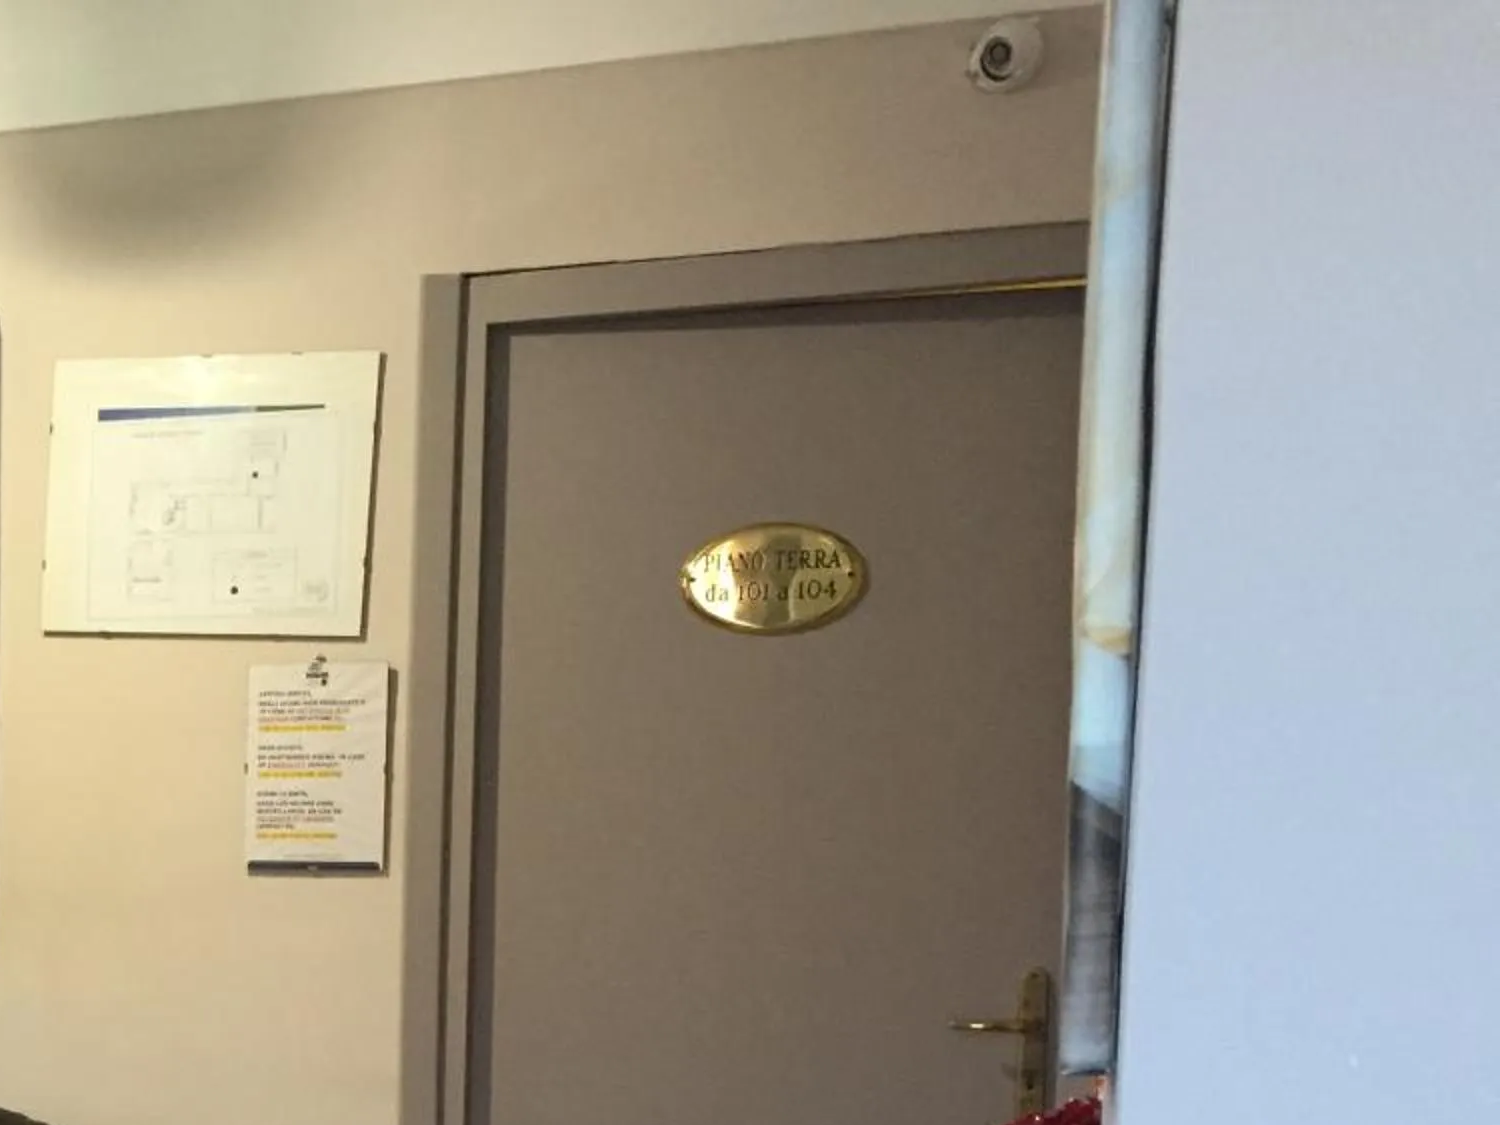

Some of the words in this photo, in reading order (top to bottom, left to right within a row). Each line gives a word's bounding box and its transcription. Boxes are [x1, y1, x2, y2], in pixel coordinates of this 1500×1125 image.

[704, 549, 765, 573] PIANO
[775, 548, 842, 570] TERRA
[705, 584, 729, 602] da
